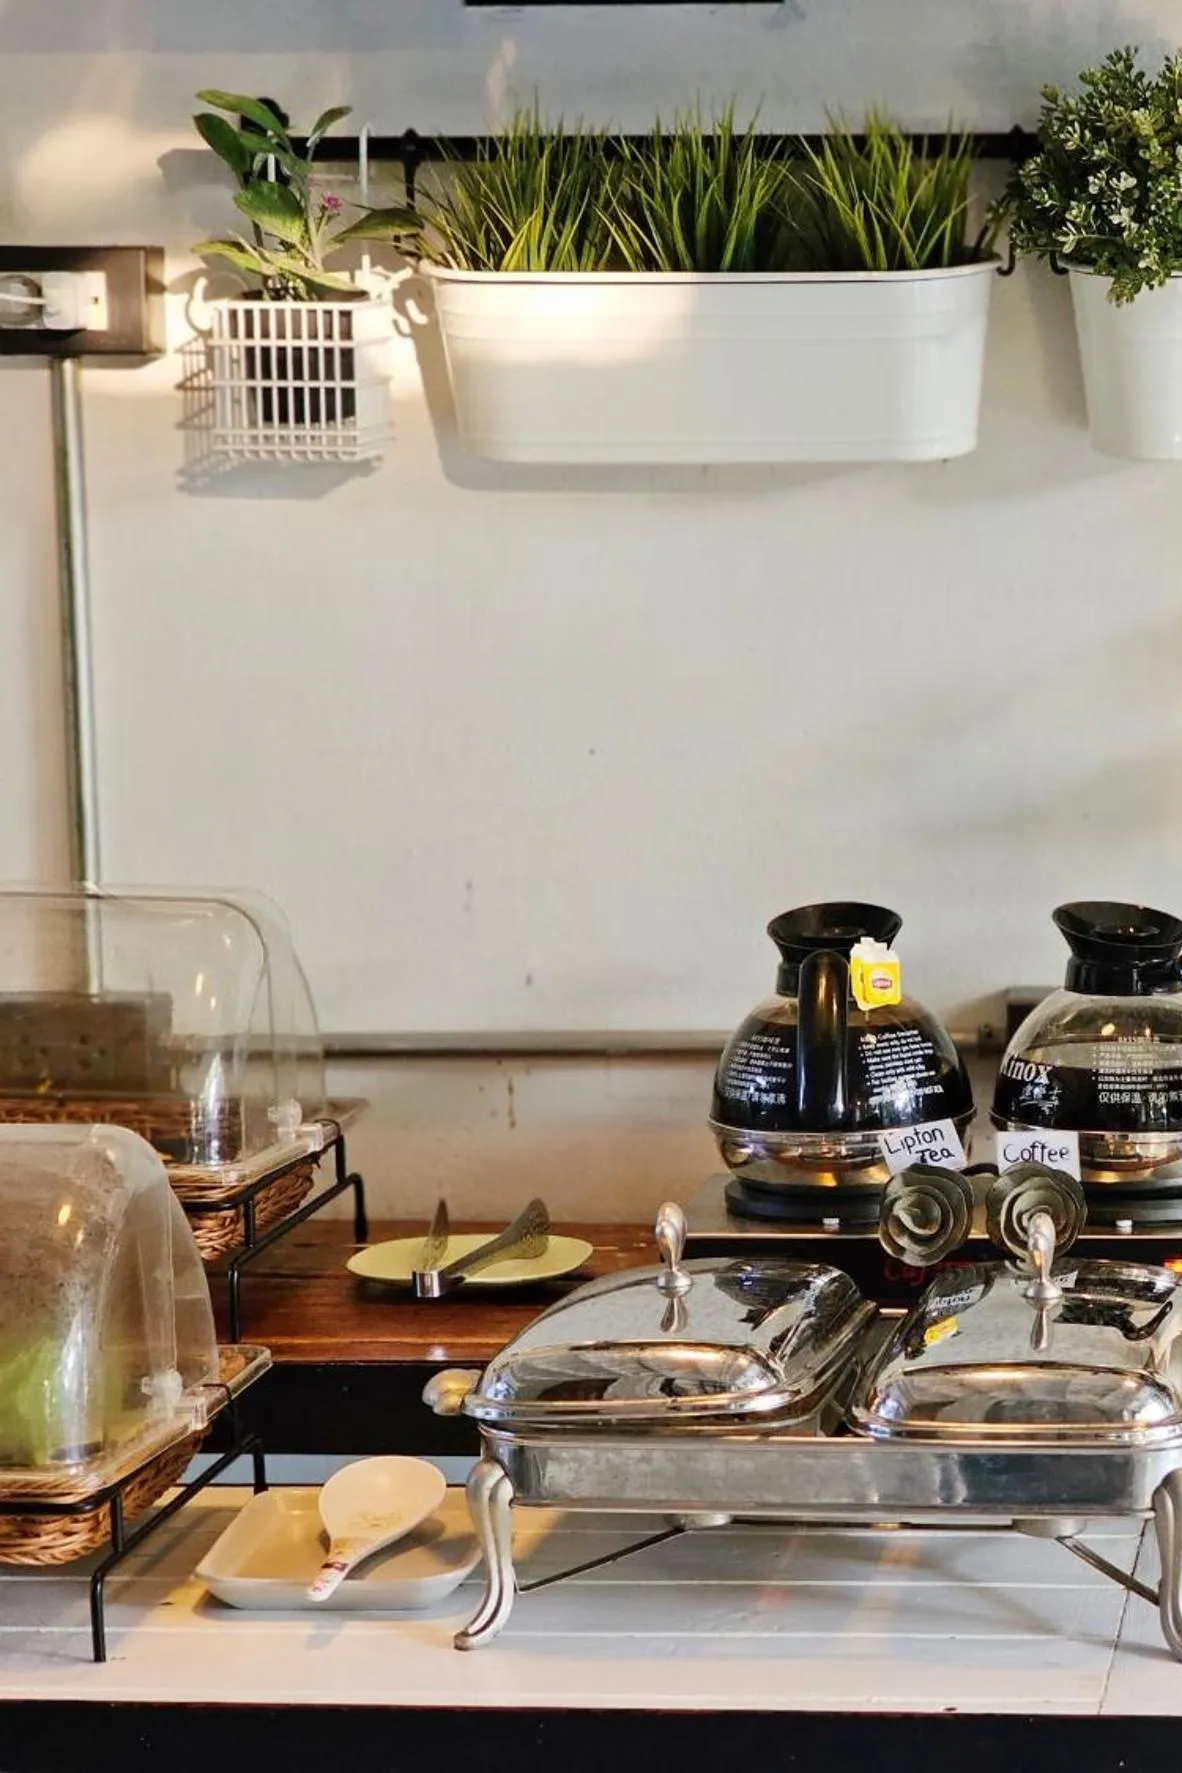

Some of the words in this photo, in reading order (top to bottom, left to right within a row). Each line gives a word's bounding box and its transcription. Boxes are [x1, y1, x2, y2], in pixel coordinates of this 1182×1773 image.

[884, 1127, 945, 1155] Lipton
[1003, 1140, 1070, 1163] Coffee
[916, 1147, 955, 1164] Tea
